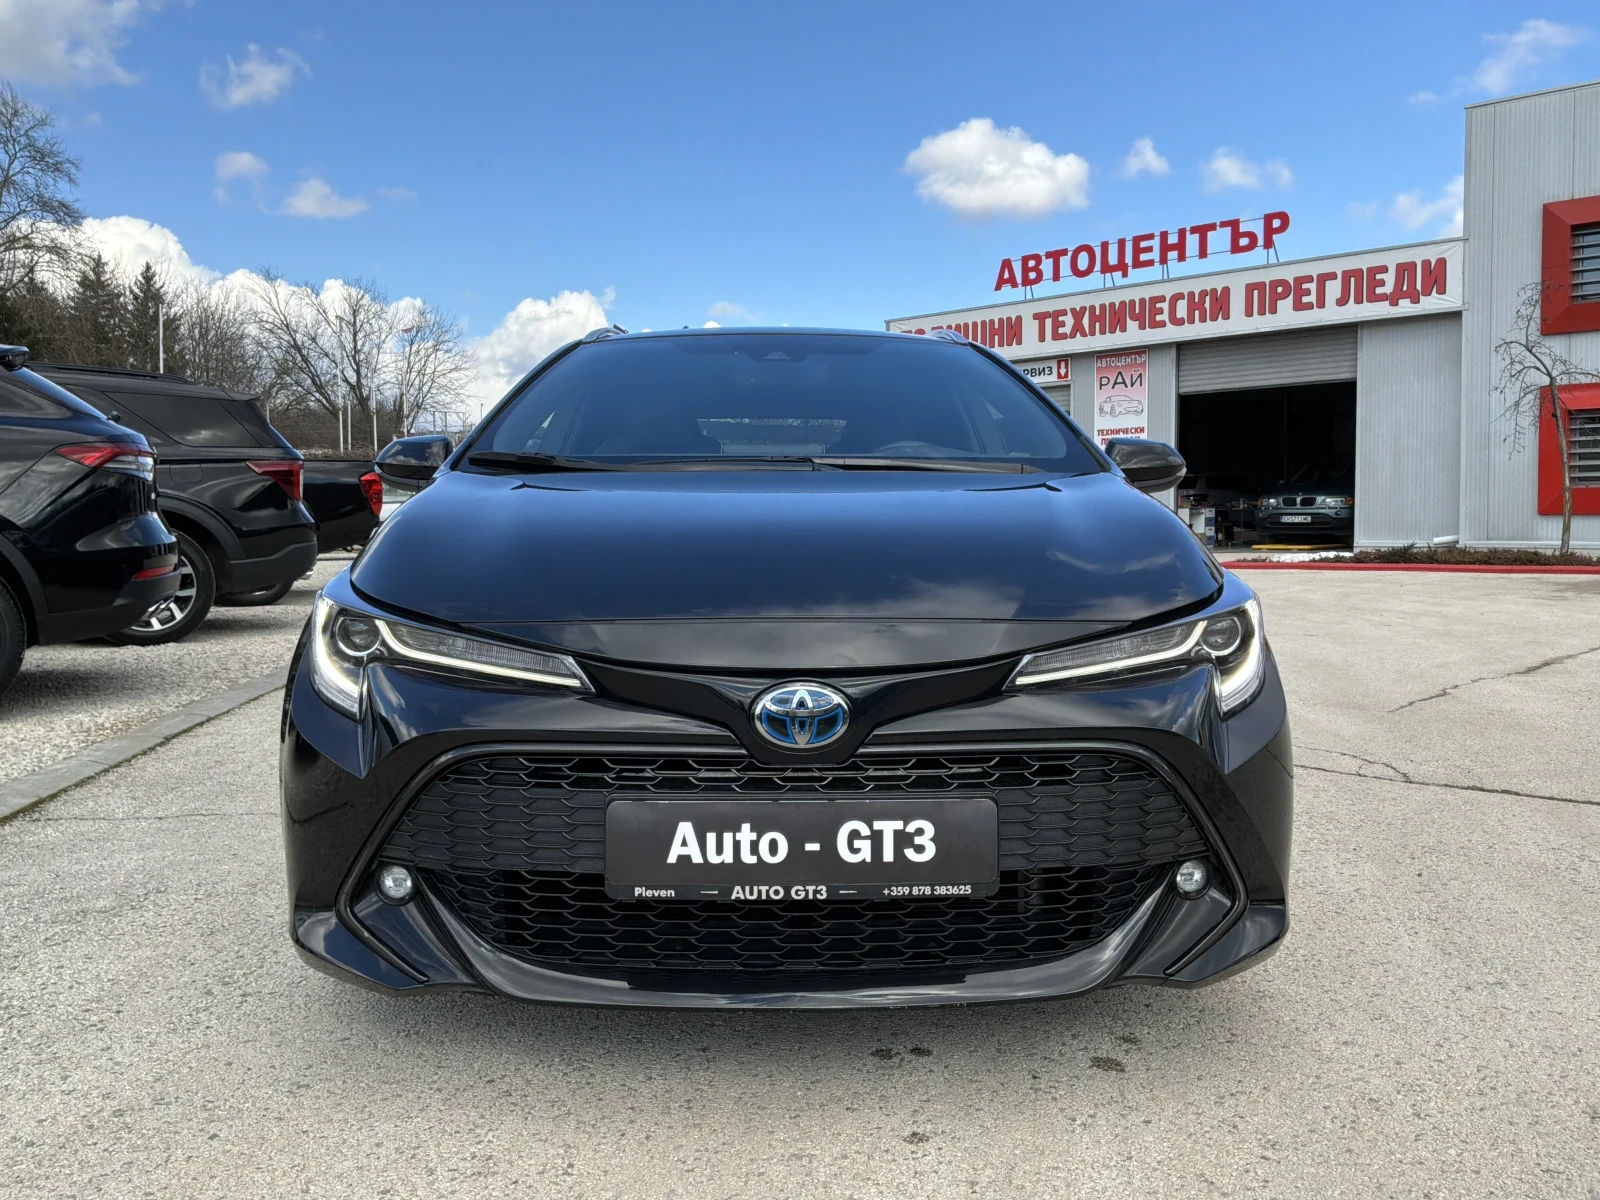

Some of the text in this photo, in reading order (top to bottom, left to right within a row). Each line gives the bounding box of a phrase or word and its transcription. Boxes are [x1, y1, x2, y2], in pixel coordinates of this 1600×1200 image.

[994, 210, 1290, 291] АВТОЦЕНТЪР
[1032, 286, 1231, 343] ТЕХНИЧЕСКИ
[1244, 256, 1448, 318] ПРЕГЛЕДИ
[1096, 354, 1146, 367] АВТОЦЕНТЪР
[1020, 365, 1053, 378] РВИЗ
[1096, 426, 1145, 437] ТЕХНИЧЕСКИ
[666, 821, 789, 865] Auto
[836, 820, 937, 863] GT3
[634, 884, 973, 900] Pleven AUTO GT3 +359 878 383625
